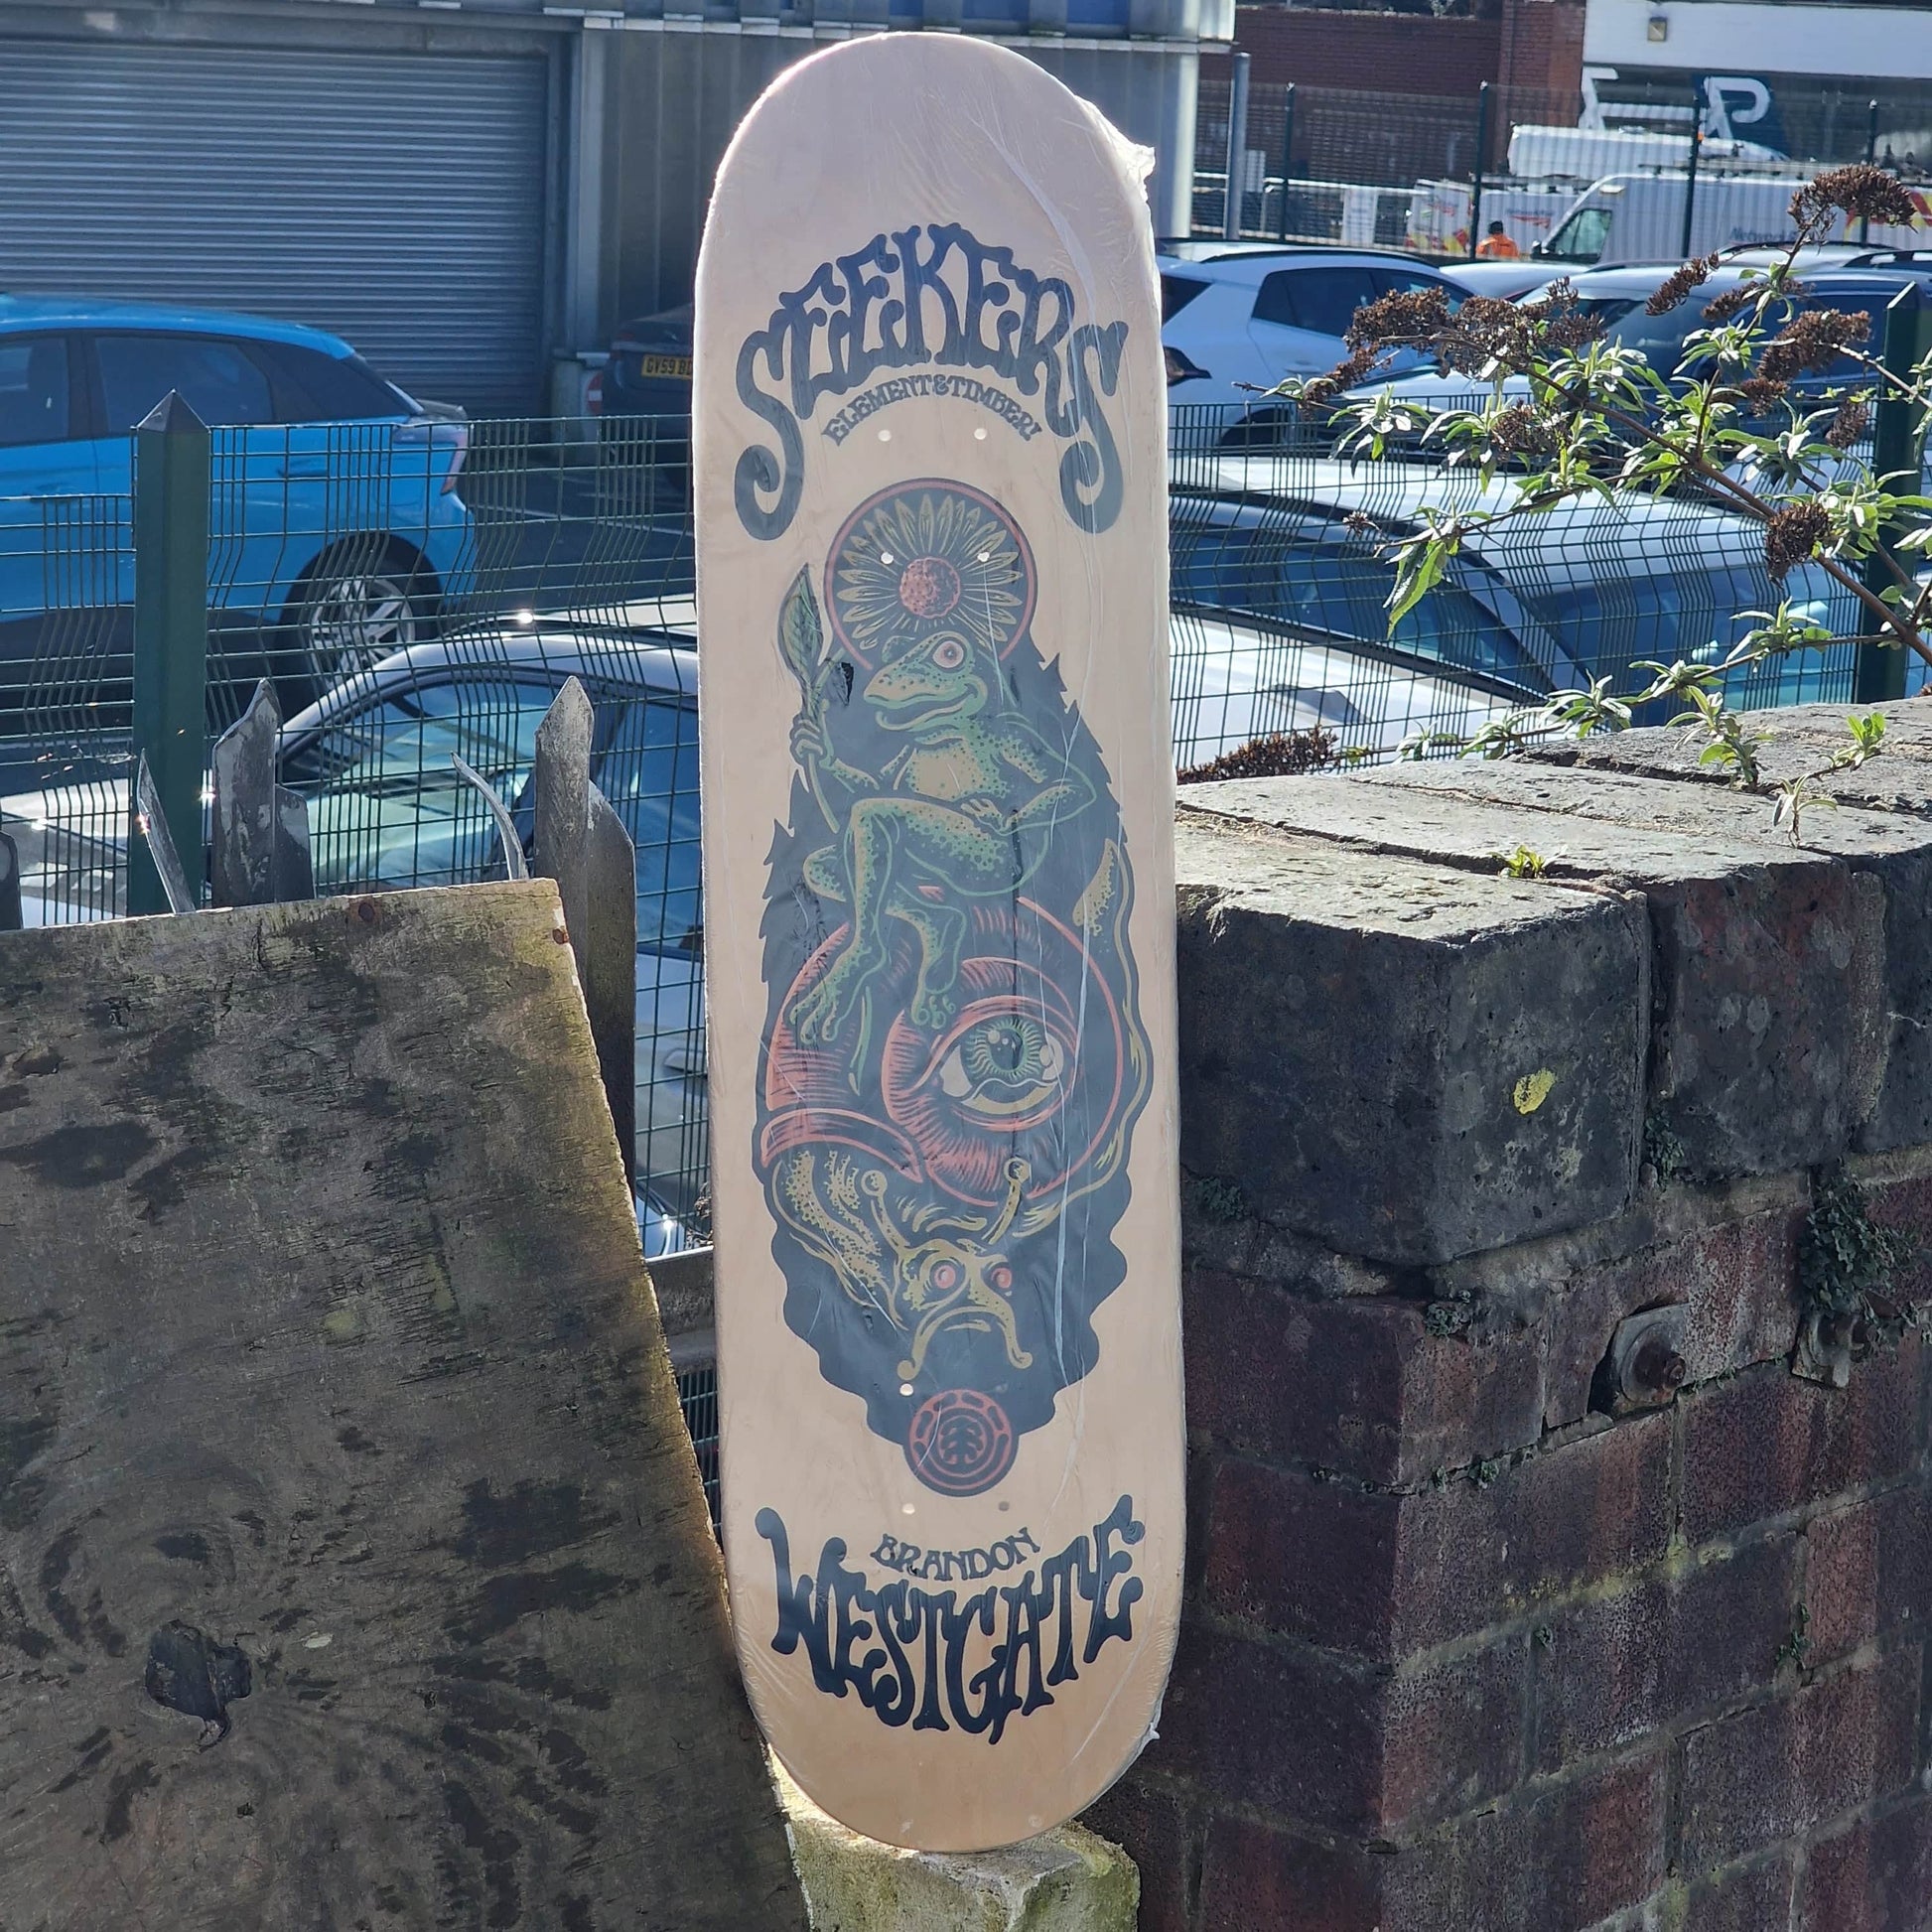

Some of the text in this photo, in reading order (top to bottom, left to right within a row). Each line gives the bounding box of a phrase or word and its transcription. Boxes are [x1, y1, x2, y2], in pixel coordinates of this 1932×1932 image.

[735, 222, 1130, 540] SEEKERS
[755, 1494, 1146, 1744] WESTGATE
[870, 1527, 1041, 1582] BRANDON
